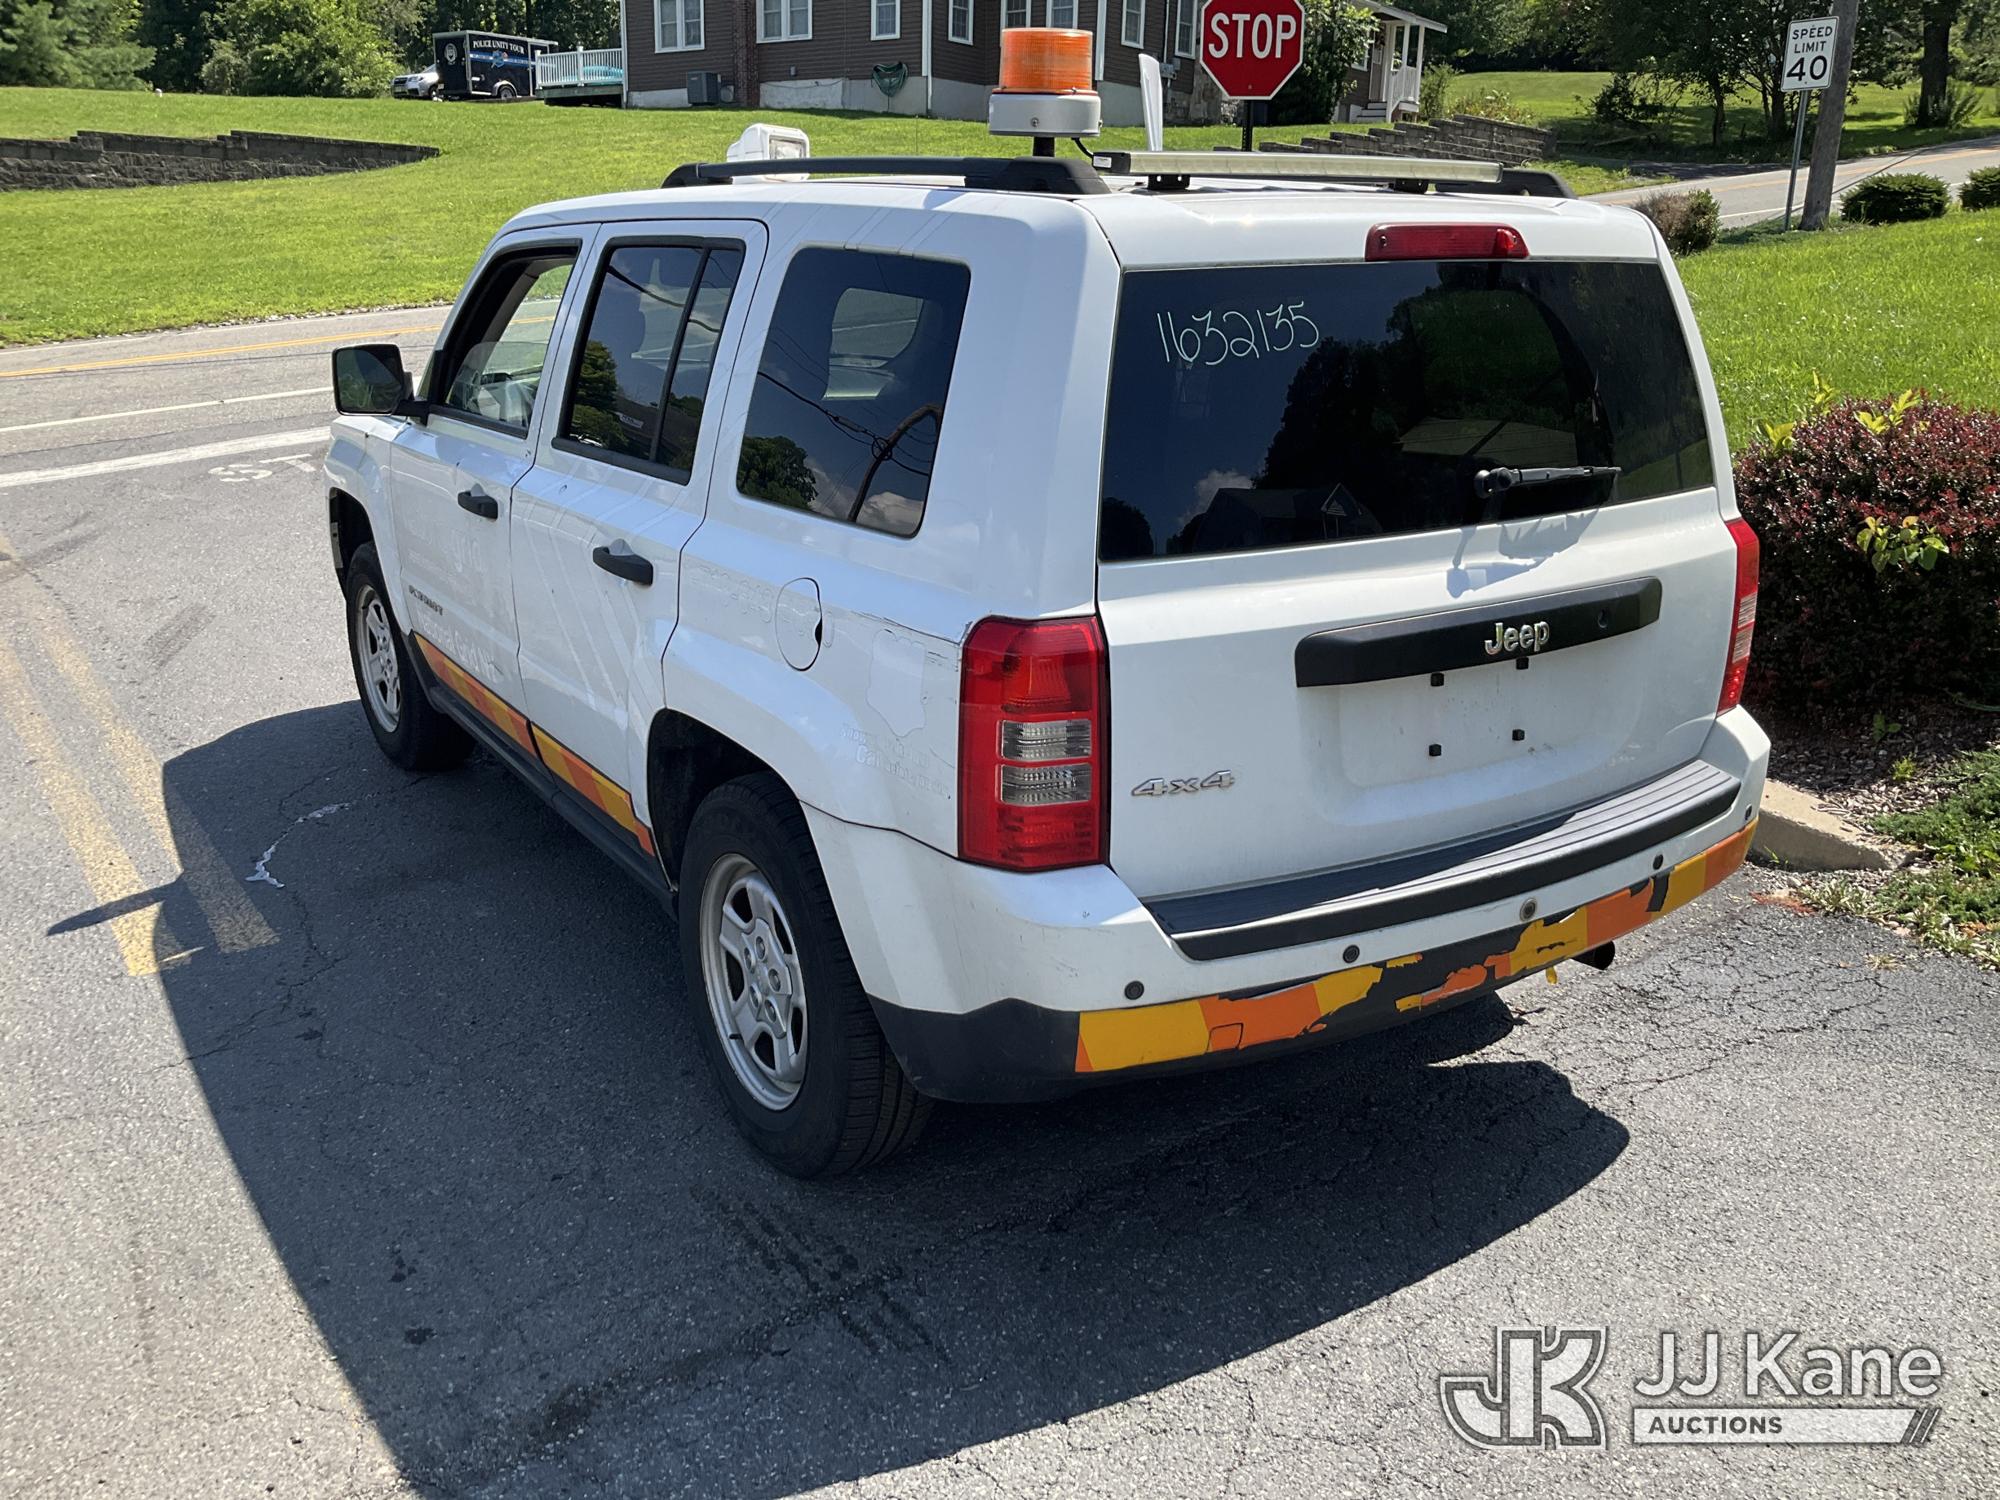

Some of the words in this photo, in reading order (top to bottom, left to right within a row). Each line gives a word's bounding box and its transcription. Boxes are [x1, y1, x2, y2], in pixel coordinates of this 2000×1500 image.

[1208, 12, 1297, 59] STOP
[1792, 26, 1833, 39] SPEED
[492, 41, 508, 49] UNITY
[509, 44, 524, 54] TOUR
[1794, 41, 1827, 53] LIMIT
[1786, 55, 1827, 81] 40
[1157, 301, 1319, 366] 1632135
[1484, 621, 1550, 655] Jeep
